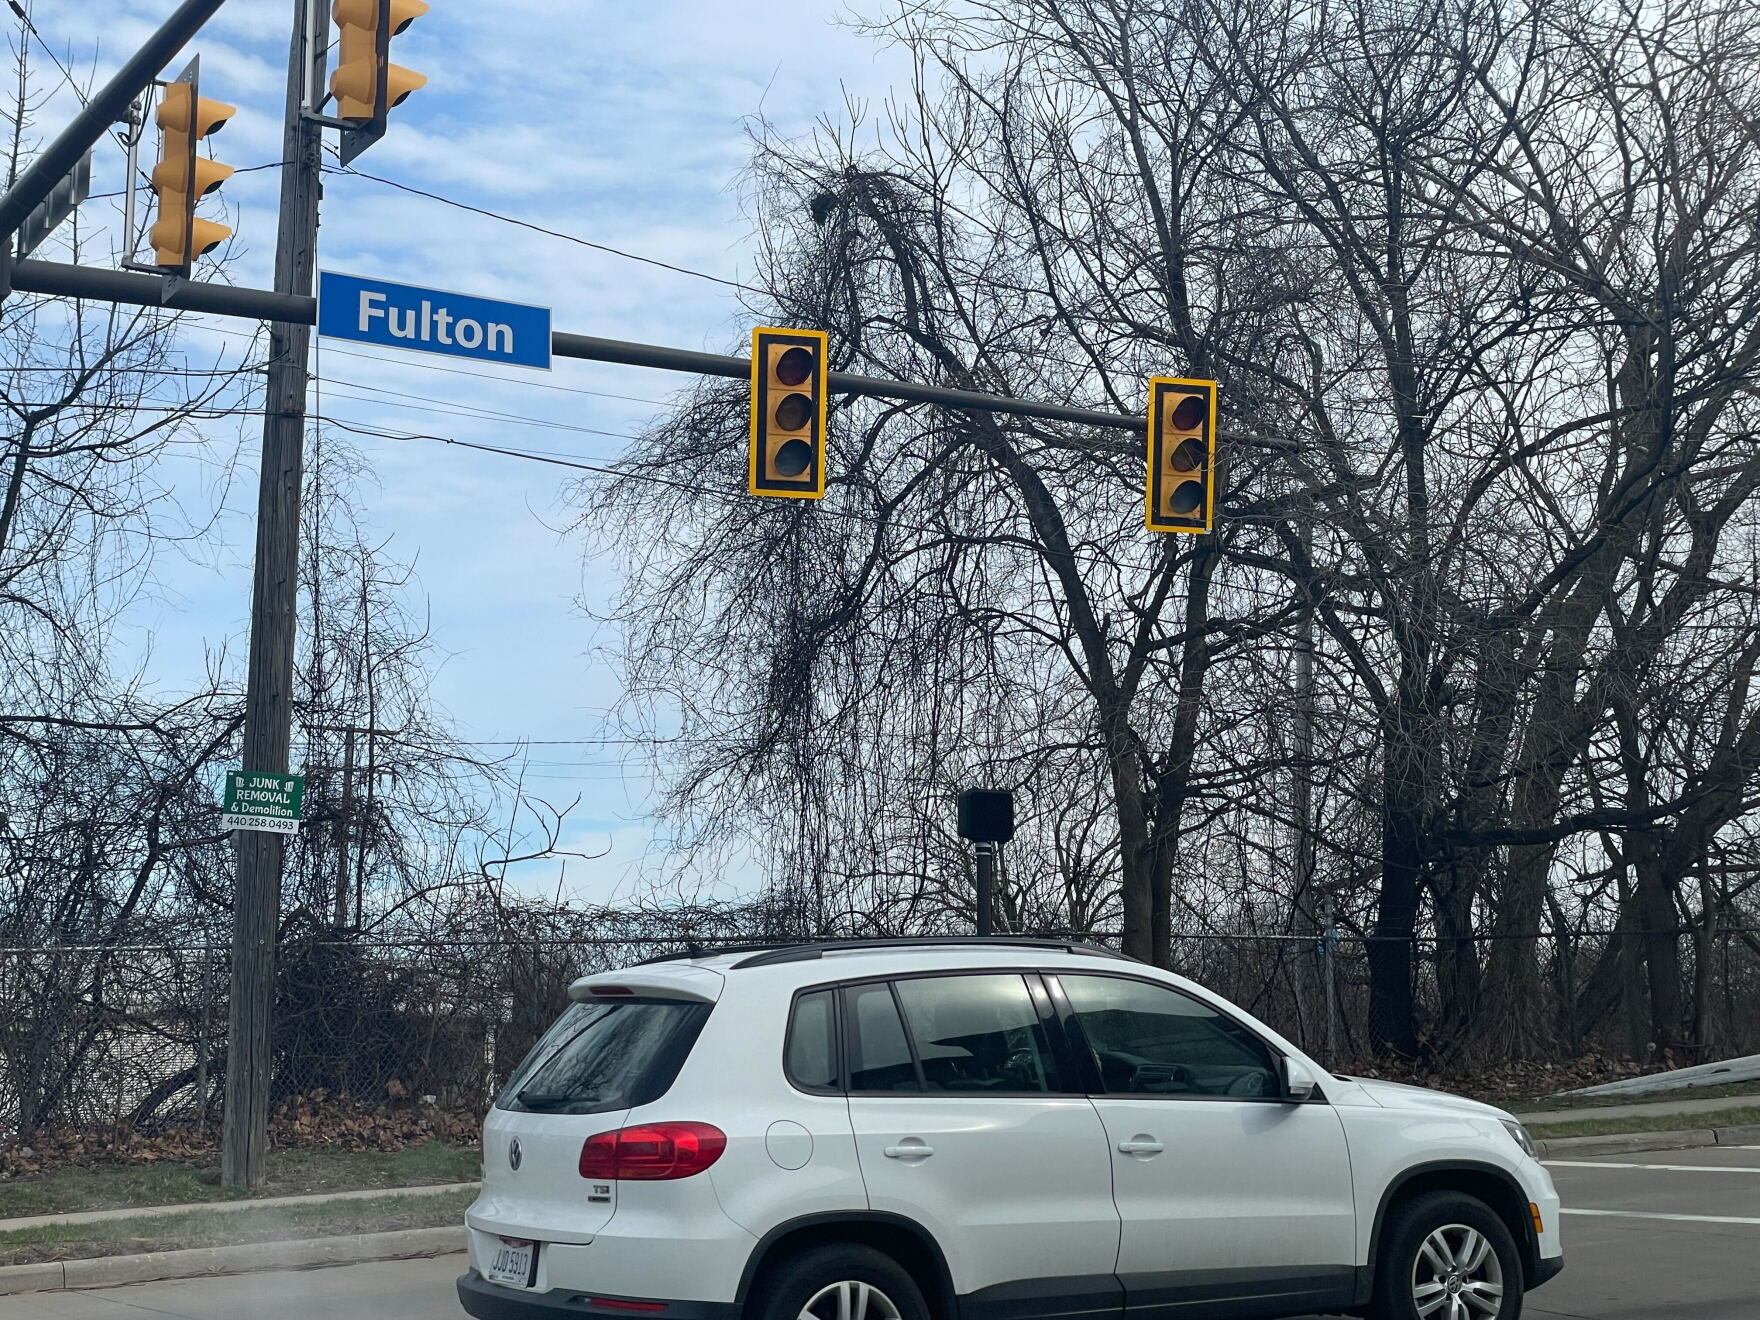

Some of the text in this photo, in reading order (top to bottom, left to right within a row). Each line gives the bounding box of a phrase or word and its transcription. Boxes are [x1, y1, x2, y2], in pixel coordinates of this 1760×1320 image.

[358, 290, 514, 354] Fulton
[249, 777, 281, 790] JUNK
[236, 789, 291, 804] REMOVAL
[230, 801, 293, 817] & Demolition
[227, 816, 294, 830] 440.258.0493
